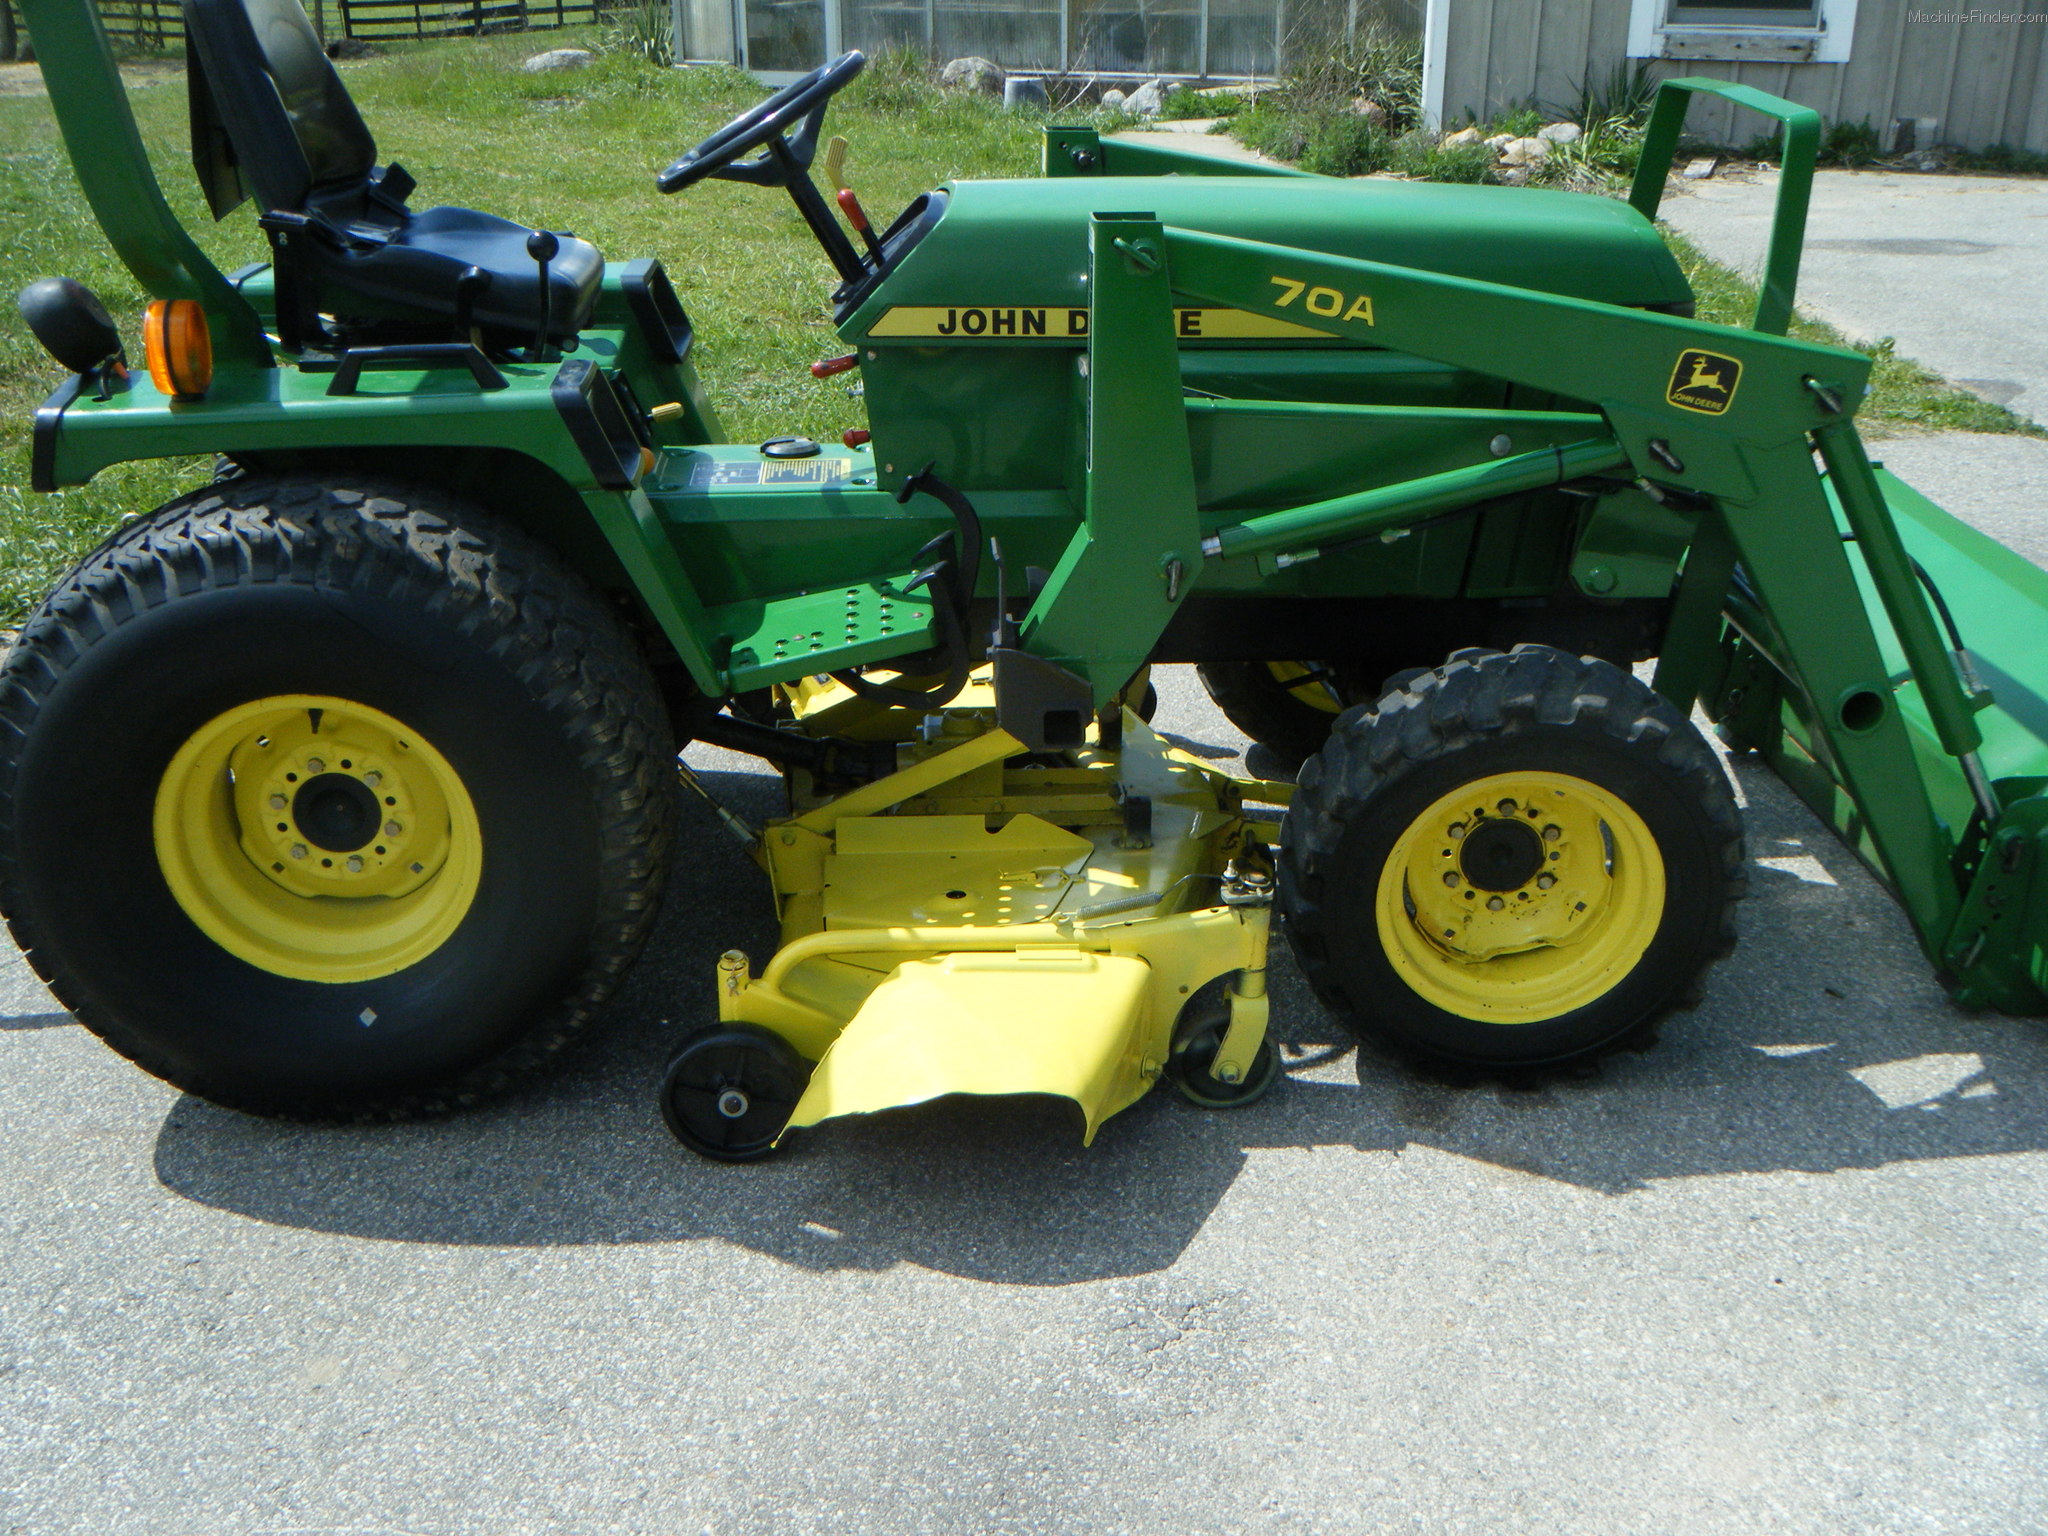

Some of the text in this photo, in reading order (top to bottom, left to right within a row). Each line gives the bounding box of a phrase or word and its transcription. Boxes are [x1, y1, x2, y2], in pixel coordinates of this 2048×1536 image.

[1270, 276, 1375, 327] 70A
[937, 309, 1046, 335] JOHN
[1671, 393, 1723, 410] JOHN DEERE
